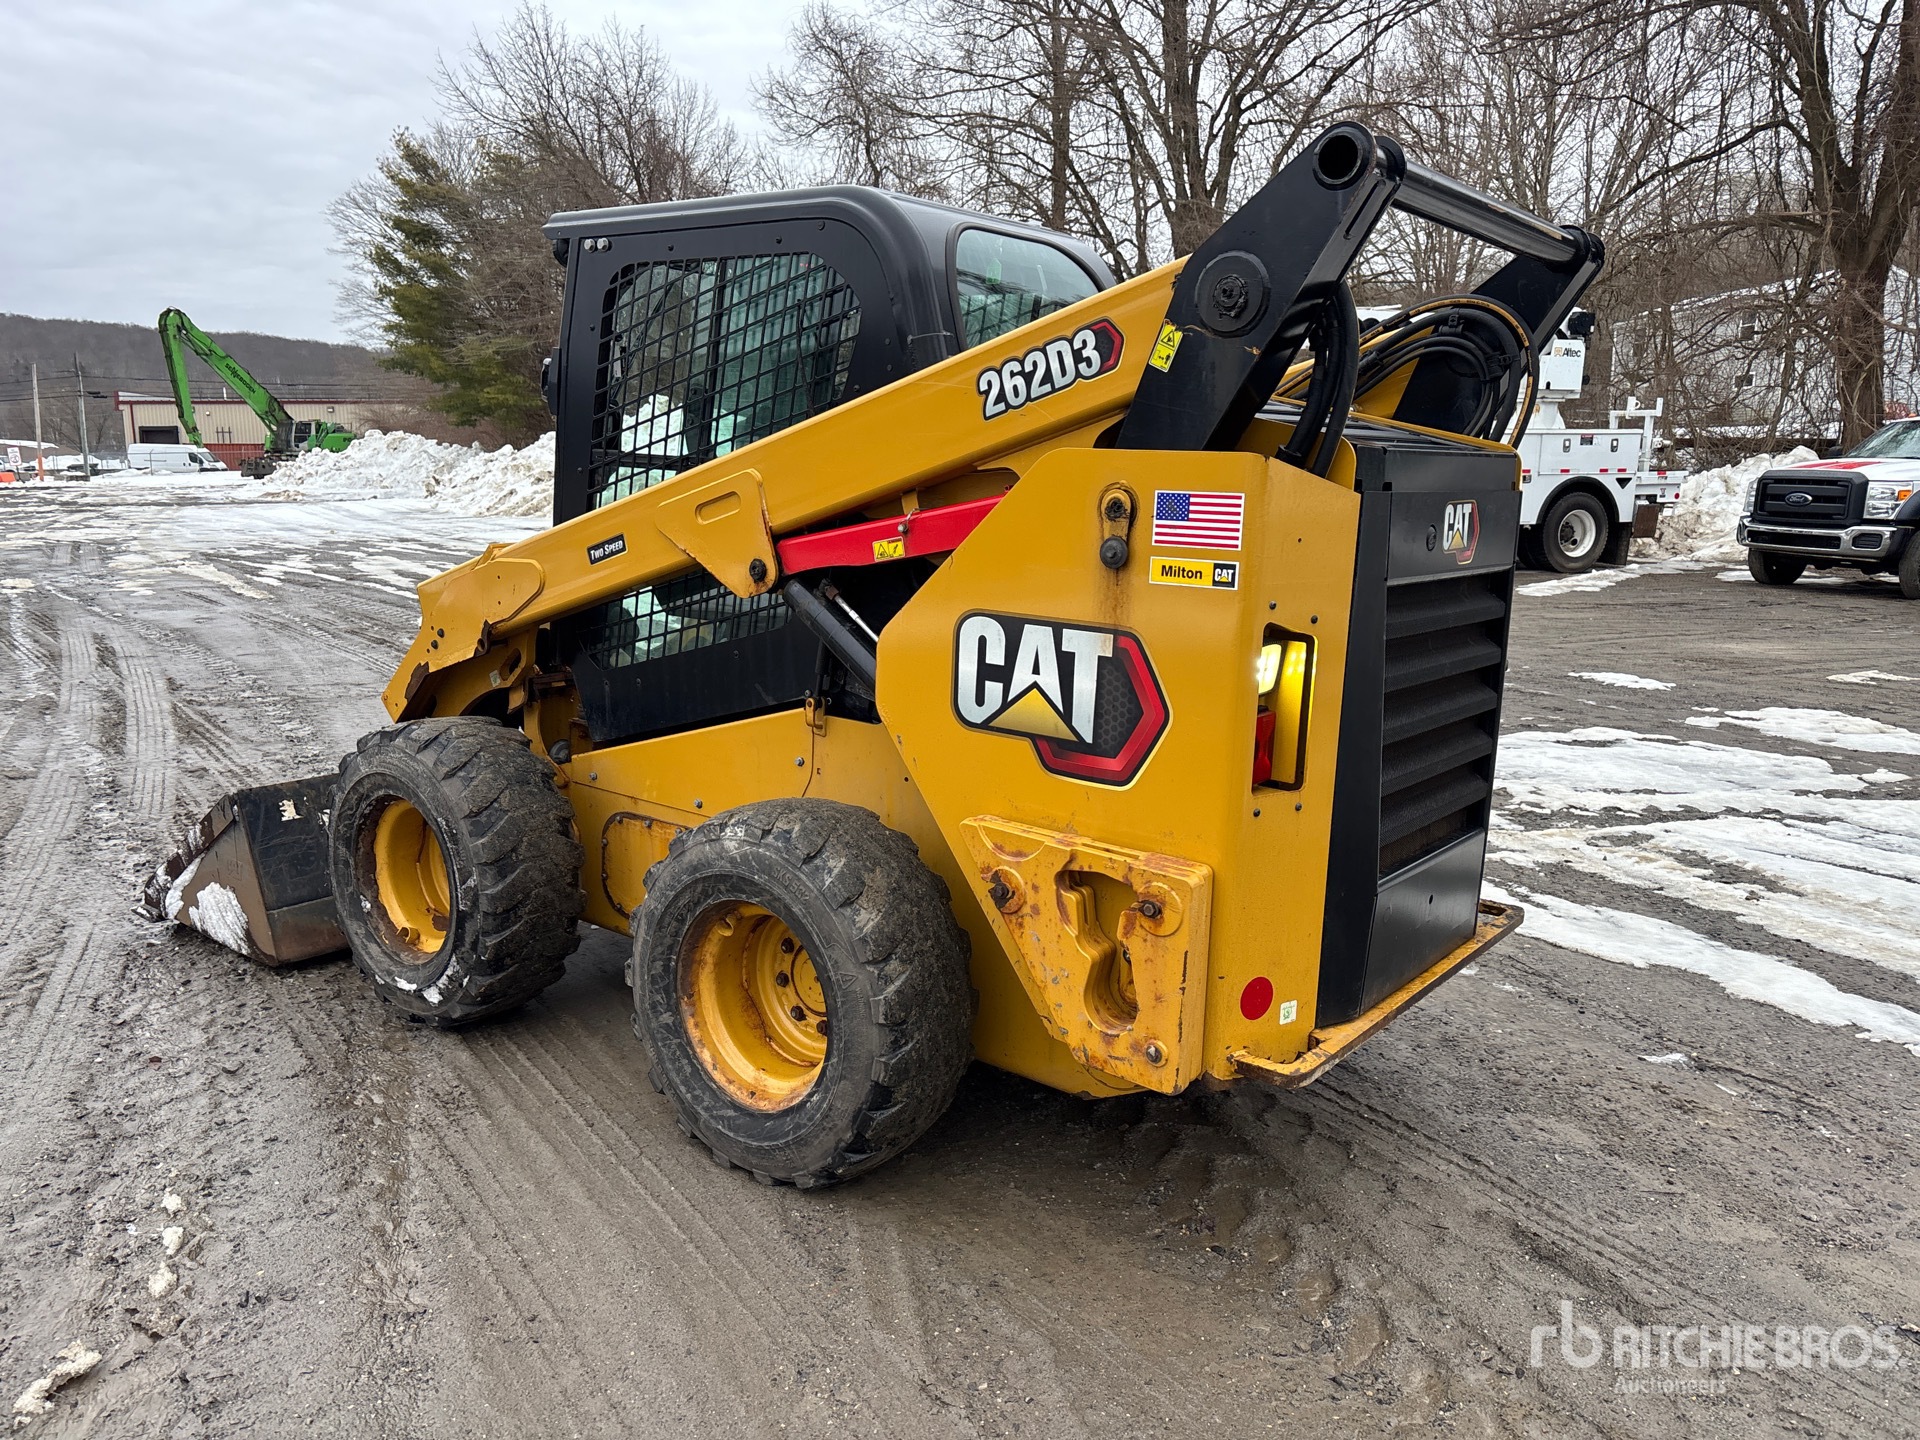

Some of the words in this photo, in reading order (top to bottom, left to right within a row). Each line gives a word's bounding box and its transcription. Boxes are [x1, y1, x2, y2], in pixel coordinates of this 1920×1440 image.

[979, 328, 1102, 418] 262D3
[1443, 503, 1472, 550] CAT
[1161, 565, 1203, 580] Milton
[1214, 568, 1234, 582] CAT
[957, 615, 1114, 744] CAT
